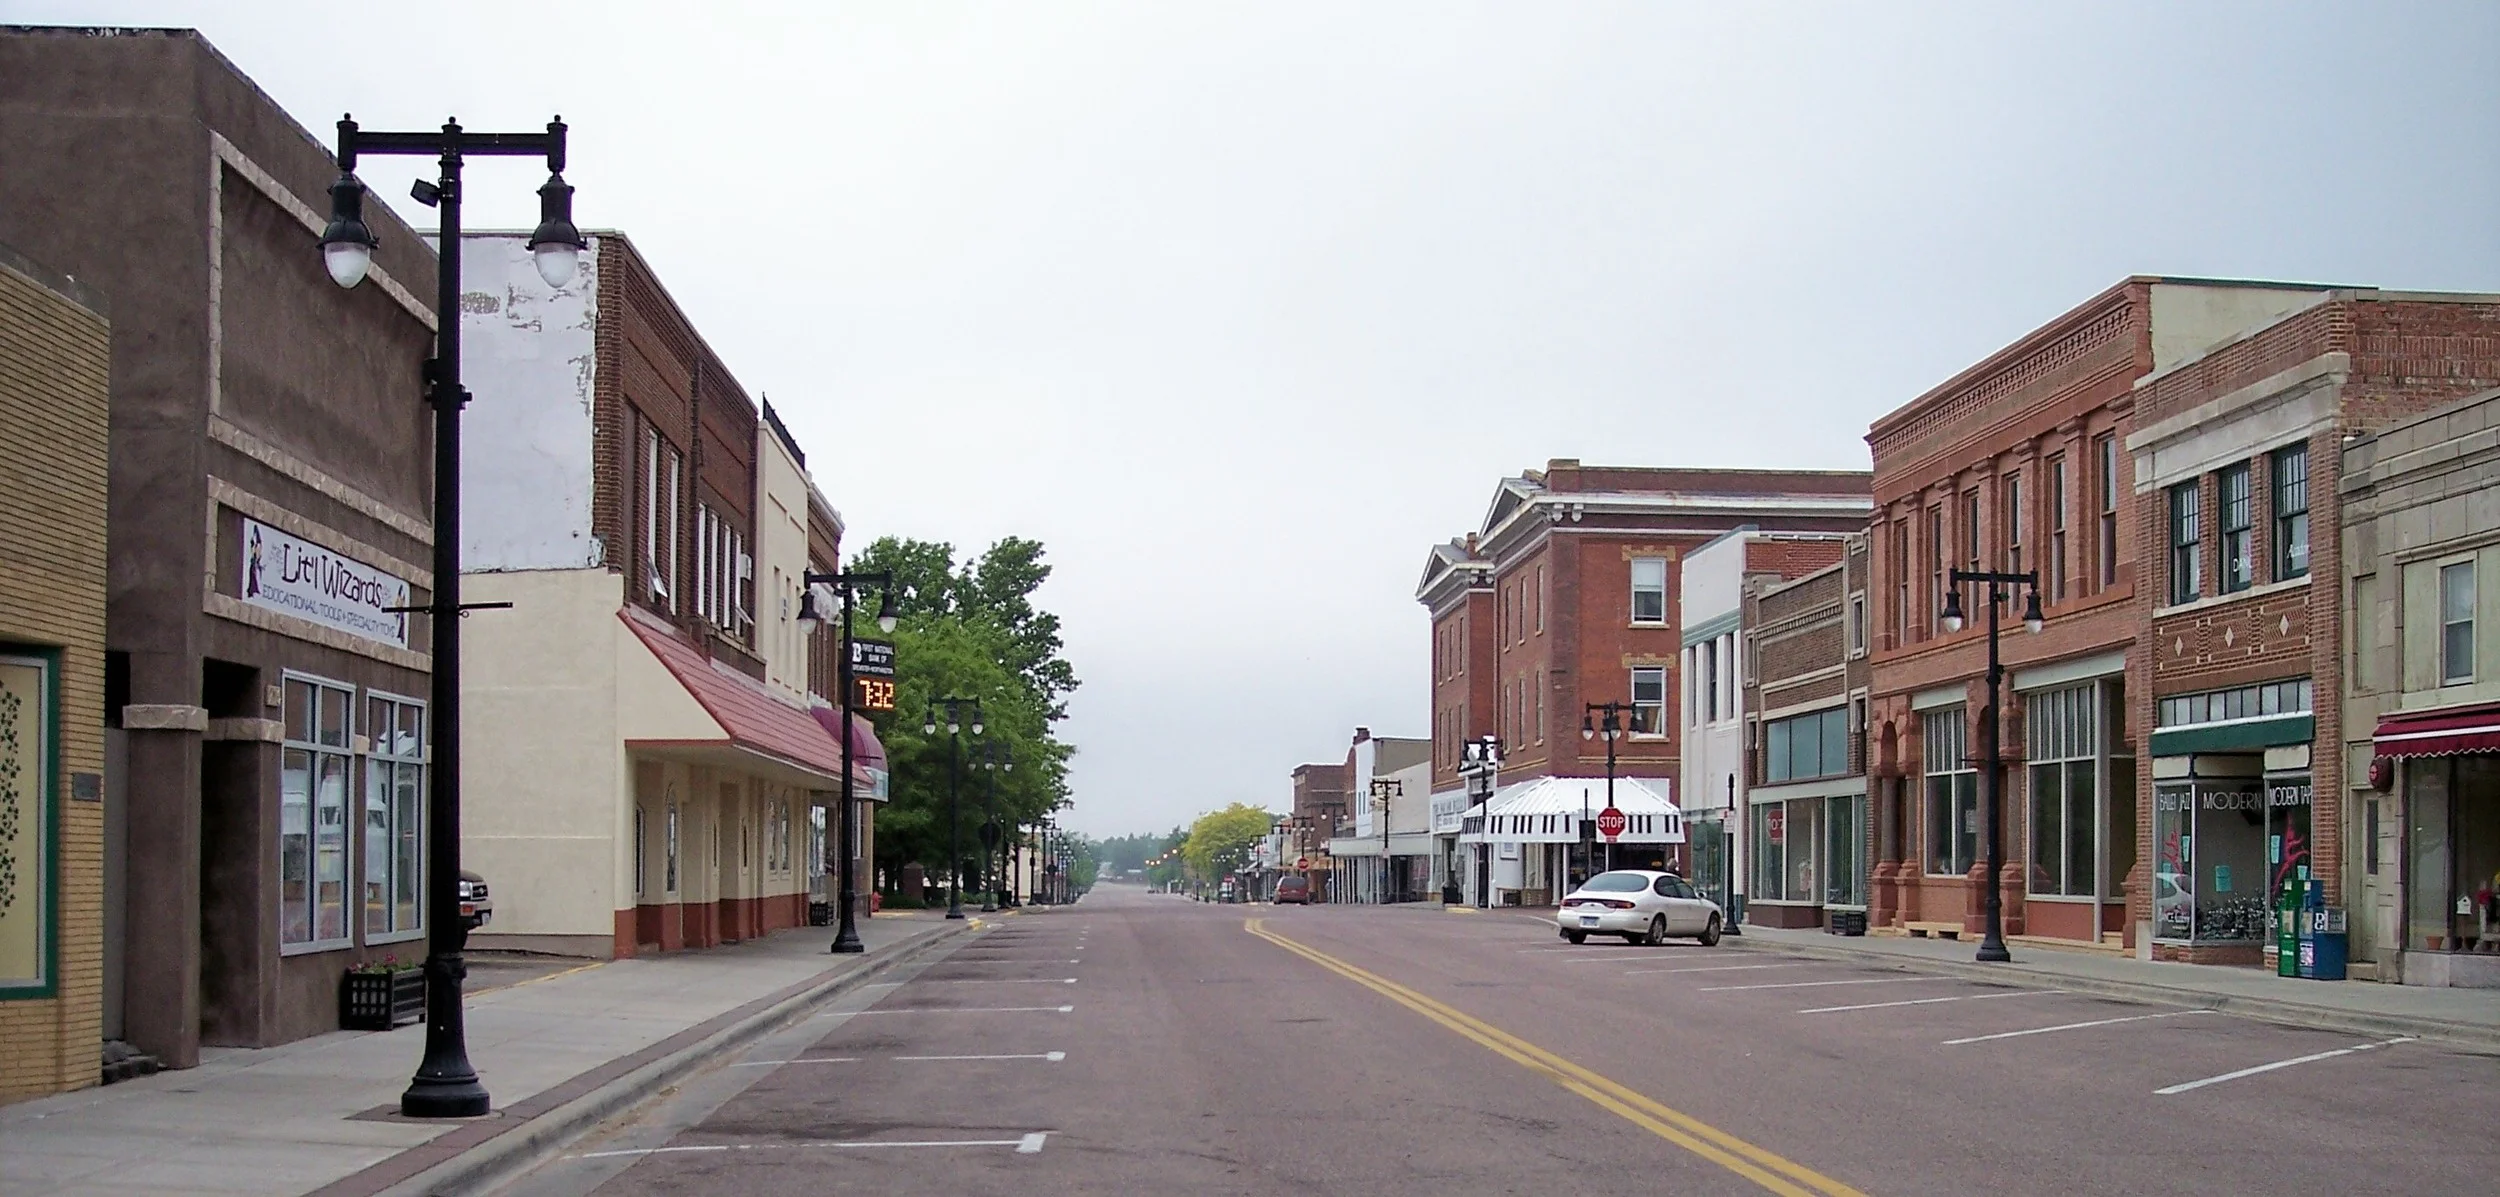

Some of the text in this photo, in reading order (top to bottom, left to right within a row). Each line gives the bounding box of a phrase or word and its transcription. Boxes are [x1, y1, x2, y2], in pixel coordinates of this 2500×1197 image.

[322, 555, 383, 609] Wizards
[262, 584, 318, 615] EDUCATIONAL
[860, 680, 893, 708] 7:32
[2203, 791, 2262, 810] MODERN
[2269, 786, 2299, 806] MODERN
[1599, 816, 1624, 829] STOP
